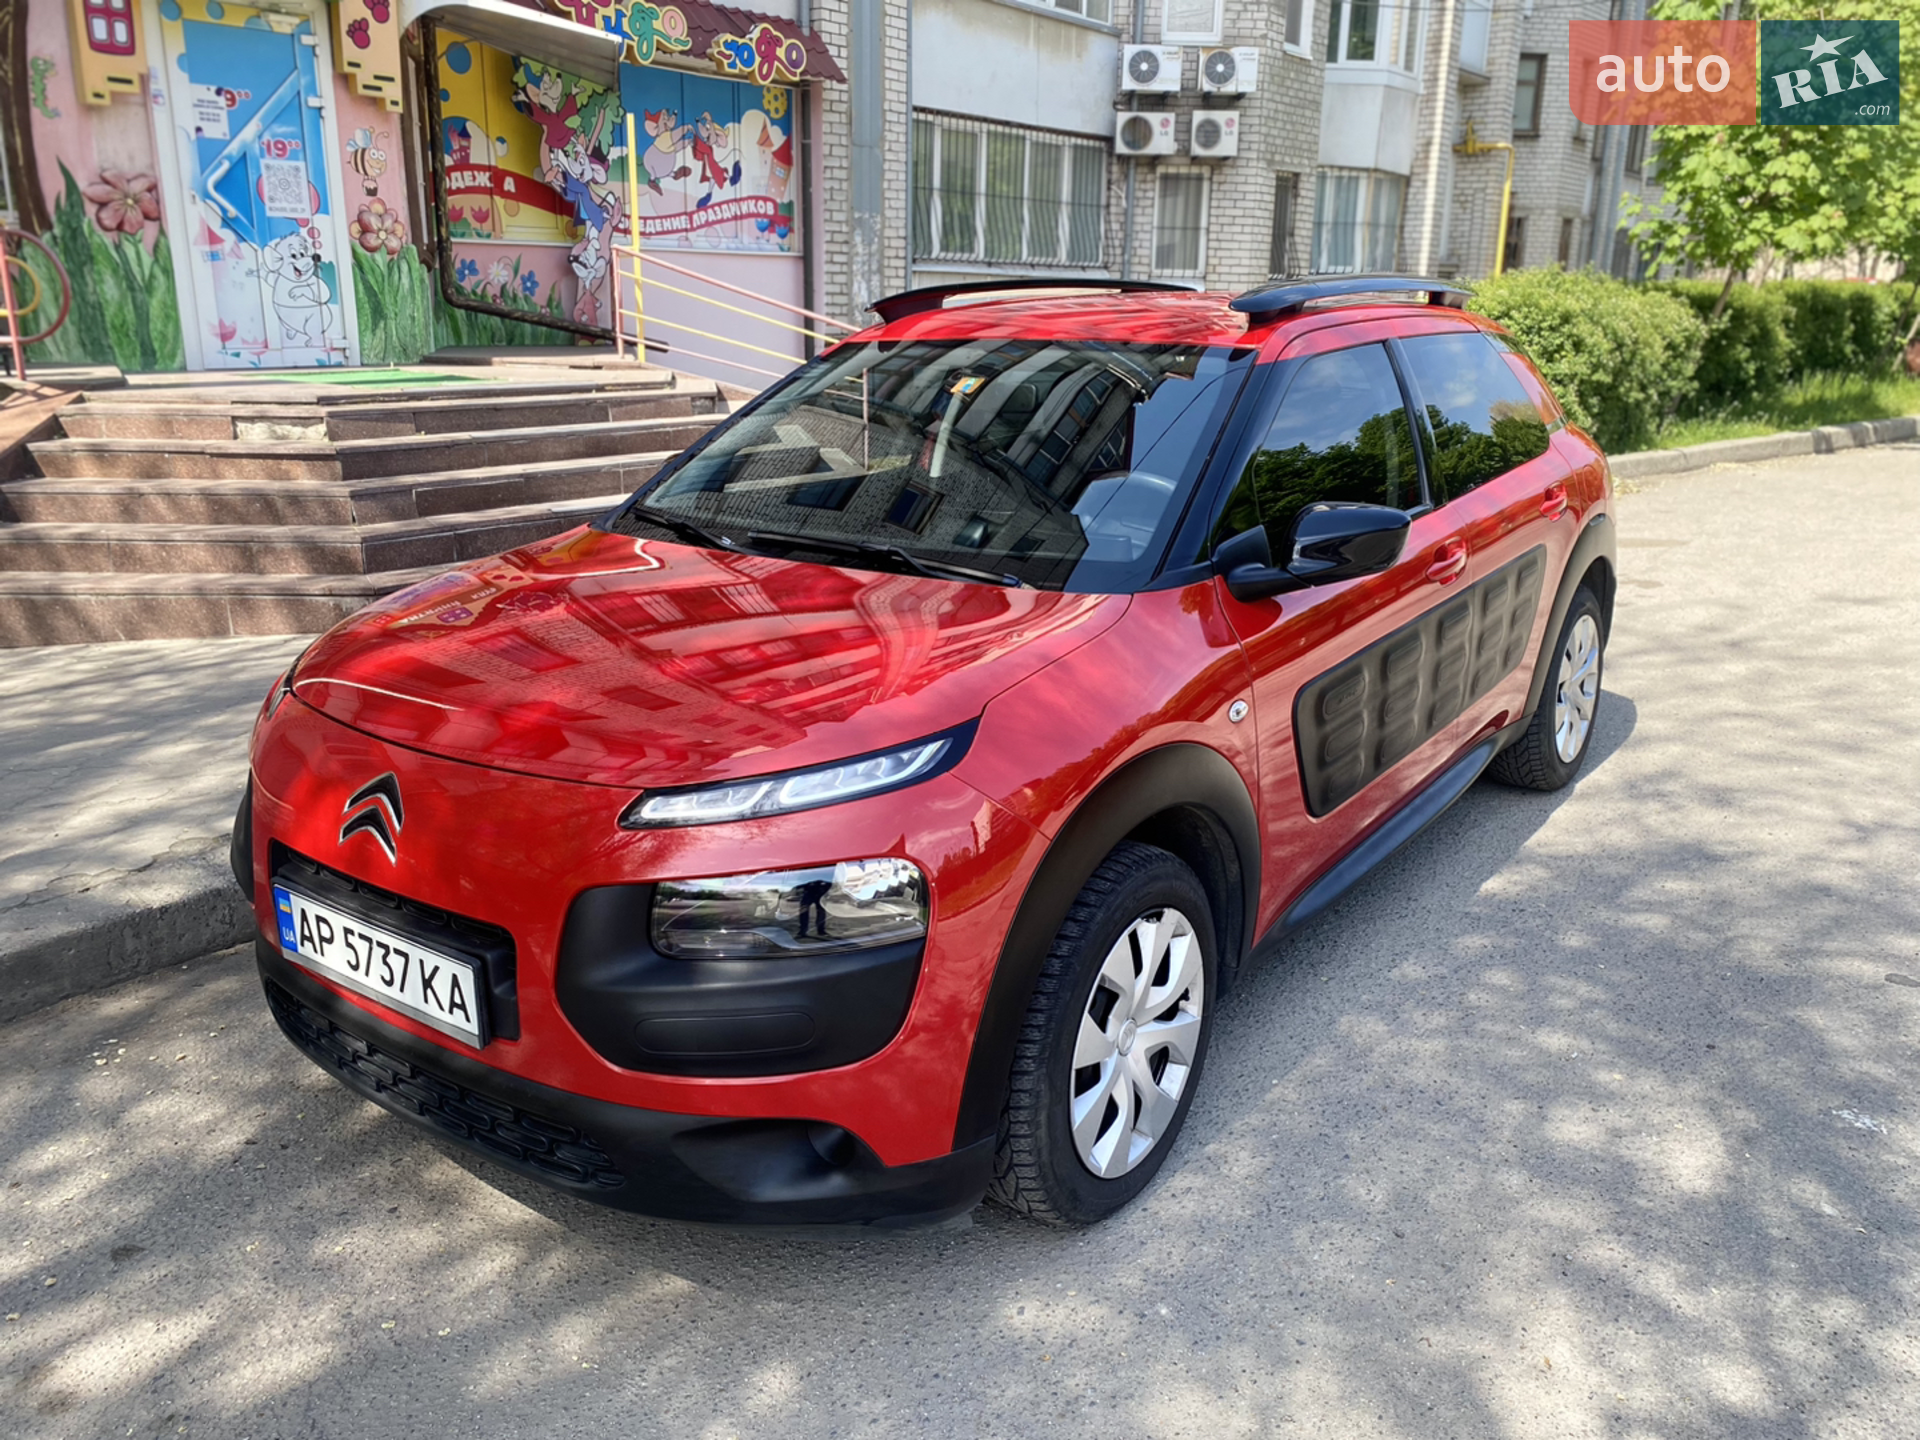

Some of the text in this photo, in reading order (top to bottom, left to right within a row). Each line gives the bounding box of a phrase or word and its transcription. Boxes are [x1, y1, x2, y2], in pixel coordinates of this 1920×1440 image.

[692, 199, 775, 228] ПРАЗДНИКОВ
[282, 926, 296, 944] UA
[299, 907, 472, 1024] AP 5737 KA
